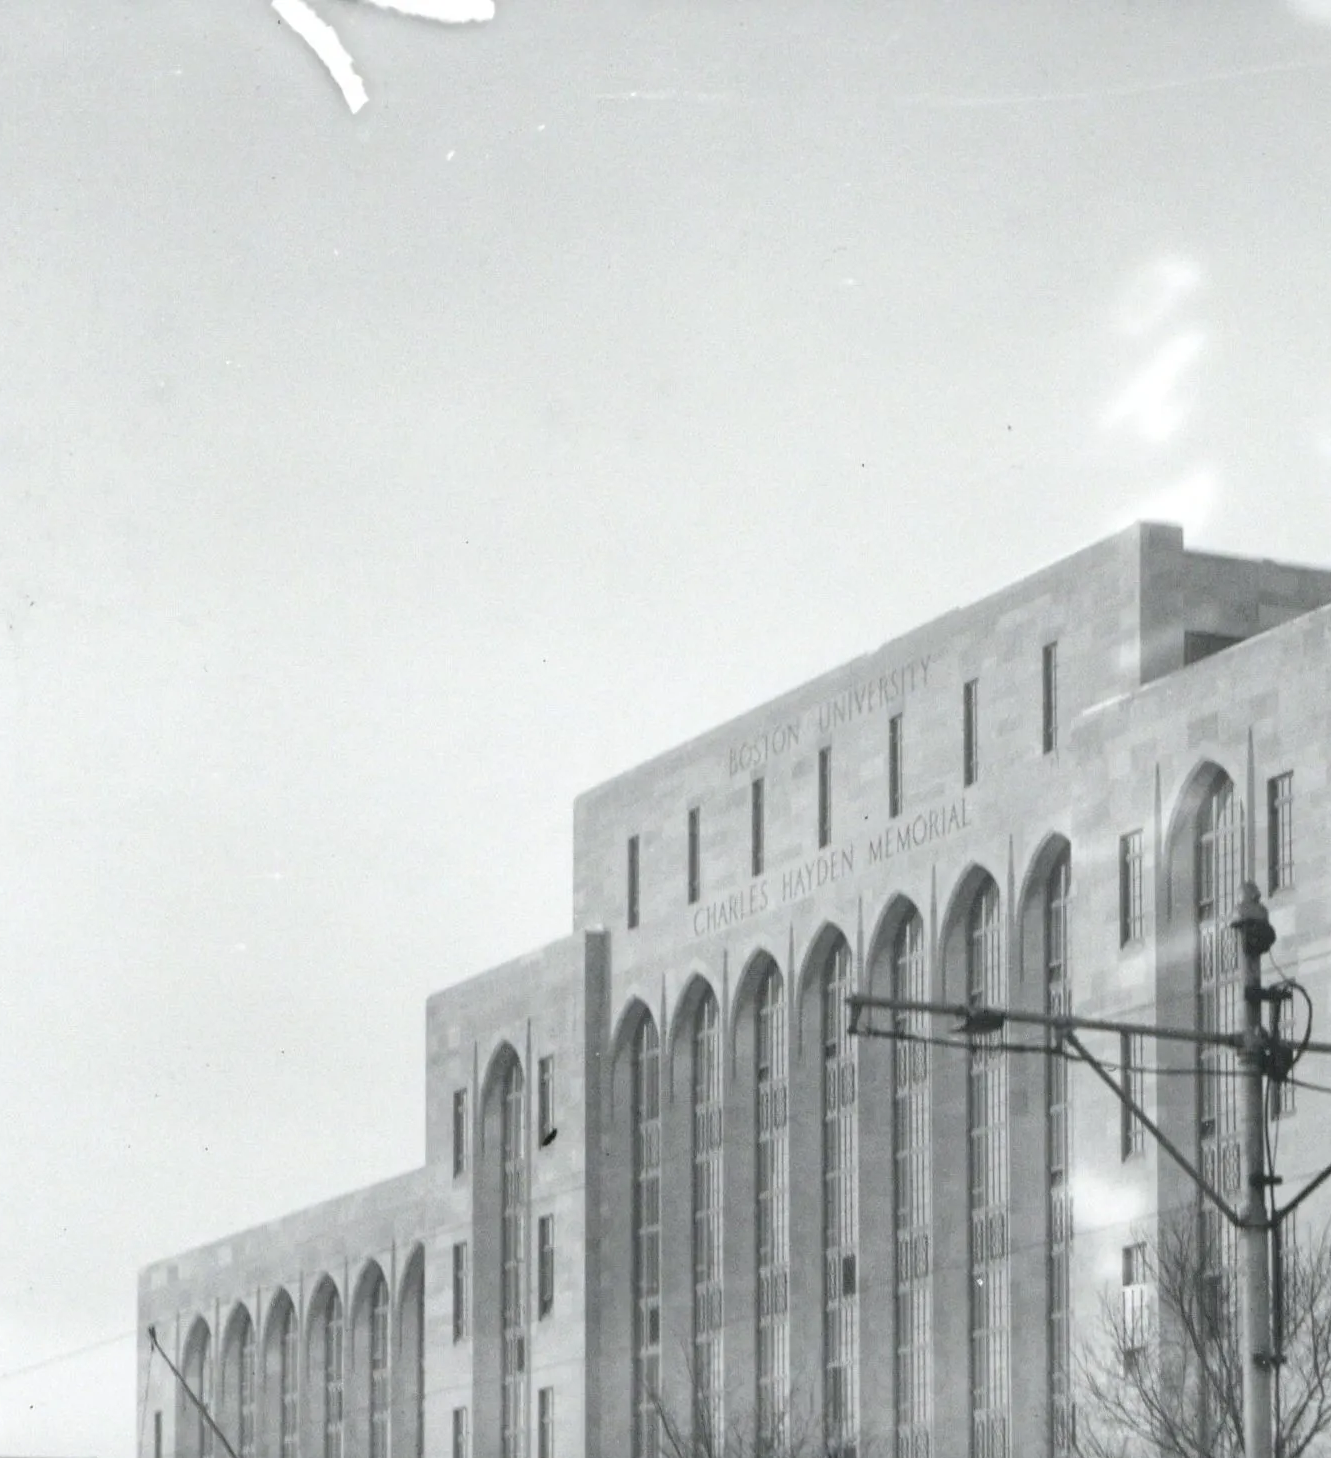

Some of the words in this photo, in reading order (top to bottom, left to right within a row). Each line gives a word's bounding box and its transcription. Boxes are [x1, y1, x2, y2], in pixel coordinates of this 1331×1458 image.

[729, 724, 800, 777] BOSTON
[819, 655, 932, 733] UNIVERSITY
[693, 880, 769, 936] CHARLES
[782, 842, 855, 901] HAYDEN
[869, 798, 970, 864] MEMORIAL
